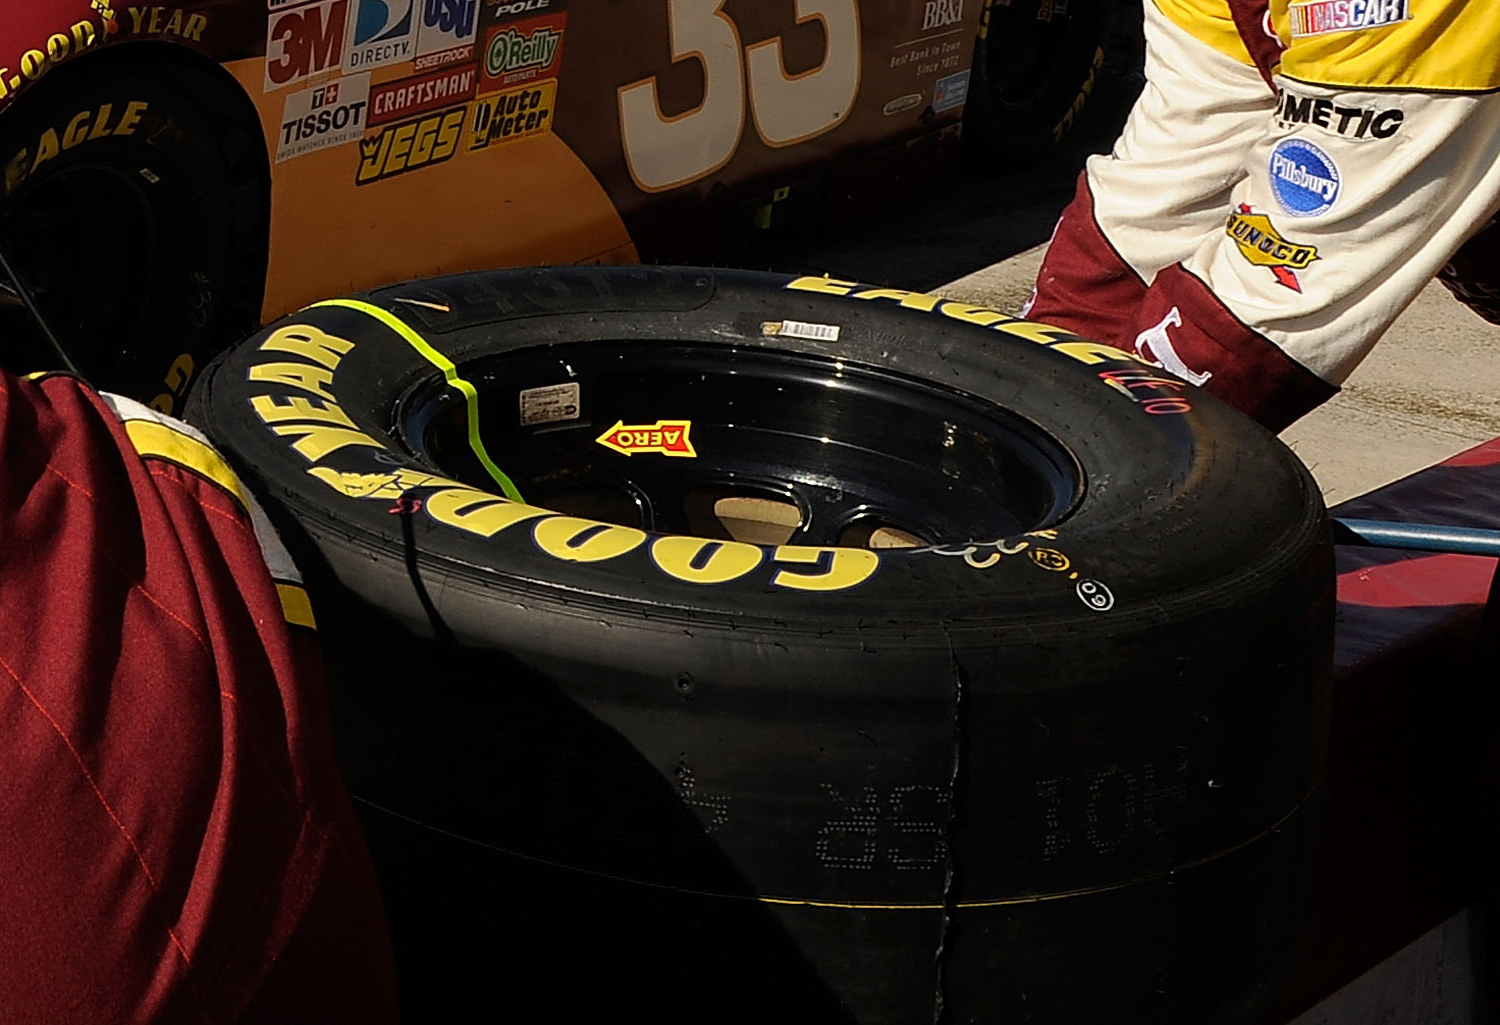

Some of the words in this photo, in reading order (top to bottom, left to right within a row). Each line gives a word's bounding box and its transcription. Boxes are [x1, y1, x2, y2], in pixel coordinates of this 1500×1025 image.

[414, 46, 471, 70] SHEETROCK
[488, 31, 561, 73] O'Reilly
[374, 71, 475, 115] CRAFTSMAN
[494, 89, 542, 118] Auto
[1273, 87, 1404, 139] METIC
[282, 101, 367, 145] TISSOT
[489, 108, 550, 140] Meter
[357, 109, 466, 182] JEGS
[1273, 151, 1338, 202] Pillsbury
[1227, 212, 1313, 266] SUNOCO
[782, 275, 1164, 369] EAGLE
[617, 429, 681, 447] AERO
